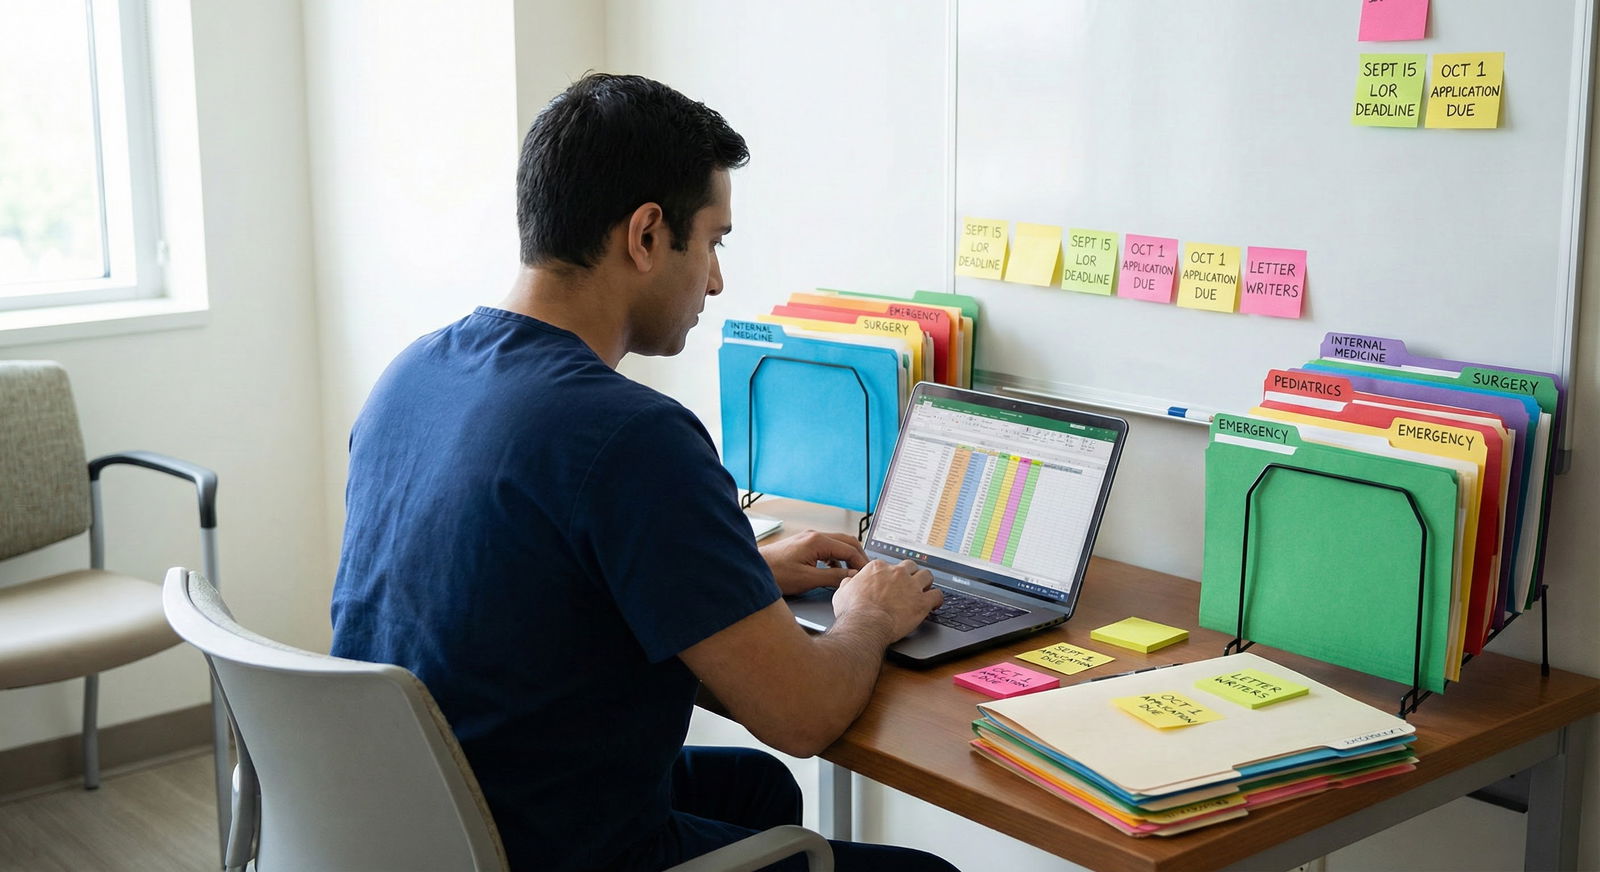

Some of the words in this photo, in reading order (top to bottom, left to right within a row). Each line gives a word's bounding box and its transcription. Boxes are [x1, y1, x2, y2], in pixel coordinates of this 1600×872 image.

[1363, 62, 1398, 77] SEPT
[1402, 62, 1417, 77] 15
[1441, 63, 1471, 78] OCT
[1476, 61, 1487, 77] 1
[1370, 83, 1398, 98] LOR
[1430, 85, 1500, 98] APPLICATION
[1355, 103, 1416, 117] DEADLINE
[1447, 103, 1476, 117] DUE
[965, 223, 988, 236] SEPT
[992, 226, 1002, 239] 15
[971, 242, 989, 253] LOR
[1071, 235, 1097, 248] SEPT
[1101, 238, 1111, 251] 15
[1131, 243, 1154, 256] OCT
[1158, 245, 1165, 258] 1
[958, 255, 1000, 270] DEADLINE
[1075, 255, 1096, 267] LOR
[1191, 251, 1214, 265] OCT
[1218, 252, 1226, 266] 1
[1122, 260, 1174, 276] APPLICATION
[1249, 261, 1296, 277] LETTER
[1065, 269, 1110, 285] DEADLINE
[1133, 277, 1155, 290] DUE
[1182, 270, 1236, 285] APPLICATION
[1195, 287, 1217, 301] DUE
[1246, 282, 1299, 298] WRITERS
[889, 306, 941, 322] EMERGENCY
[731, 322, 772, 333] INTERNAL
[864, 319, 909, 335] SURGERY
[733, 330, 773, 342] MEDICINE
[1331, 335, 1387, 351] INTERNAL
[1334, 347, 1386, 363] MEDICINE
[1274, 375, 1341, 397] PEDIATRICS
[1473, 372, 1539, 395] SURGERY
[1219, 418, 1288, 444] EMERGENCY
[1398, 424, 1475, 451] EMERGENCY
[1054, 645, 1084, 656] SEPT
[1040, 649, 1093, 668] APPLICATION
[1040, 655, 1064, 666] DUE
[992, 667, 1023, 678] OCT
[1214, 676, 1271, 700] WRITERS
[1230, 673, 1282, 693] LETTER
[1161, 694, 1191, 707] OCT
[1138, 703, 1163, 716] DUE
[1139, 695, 1198, 724] APPLICATION
